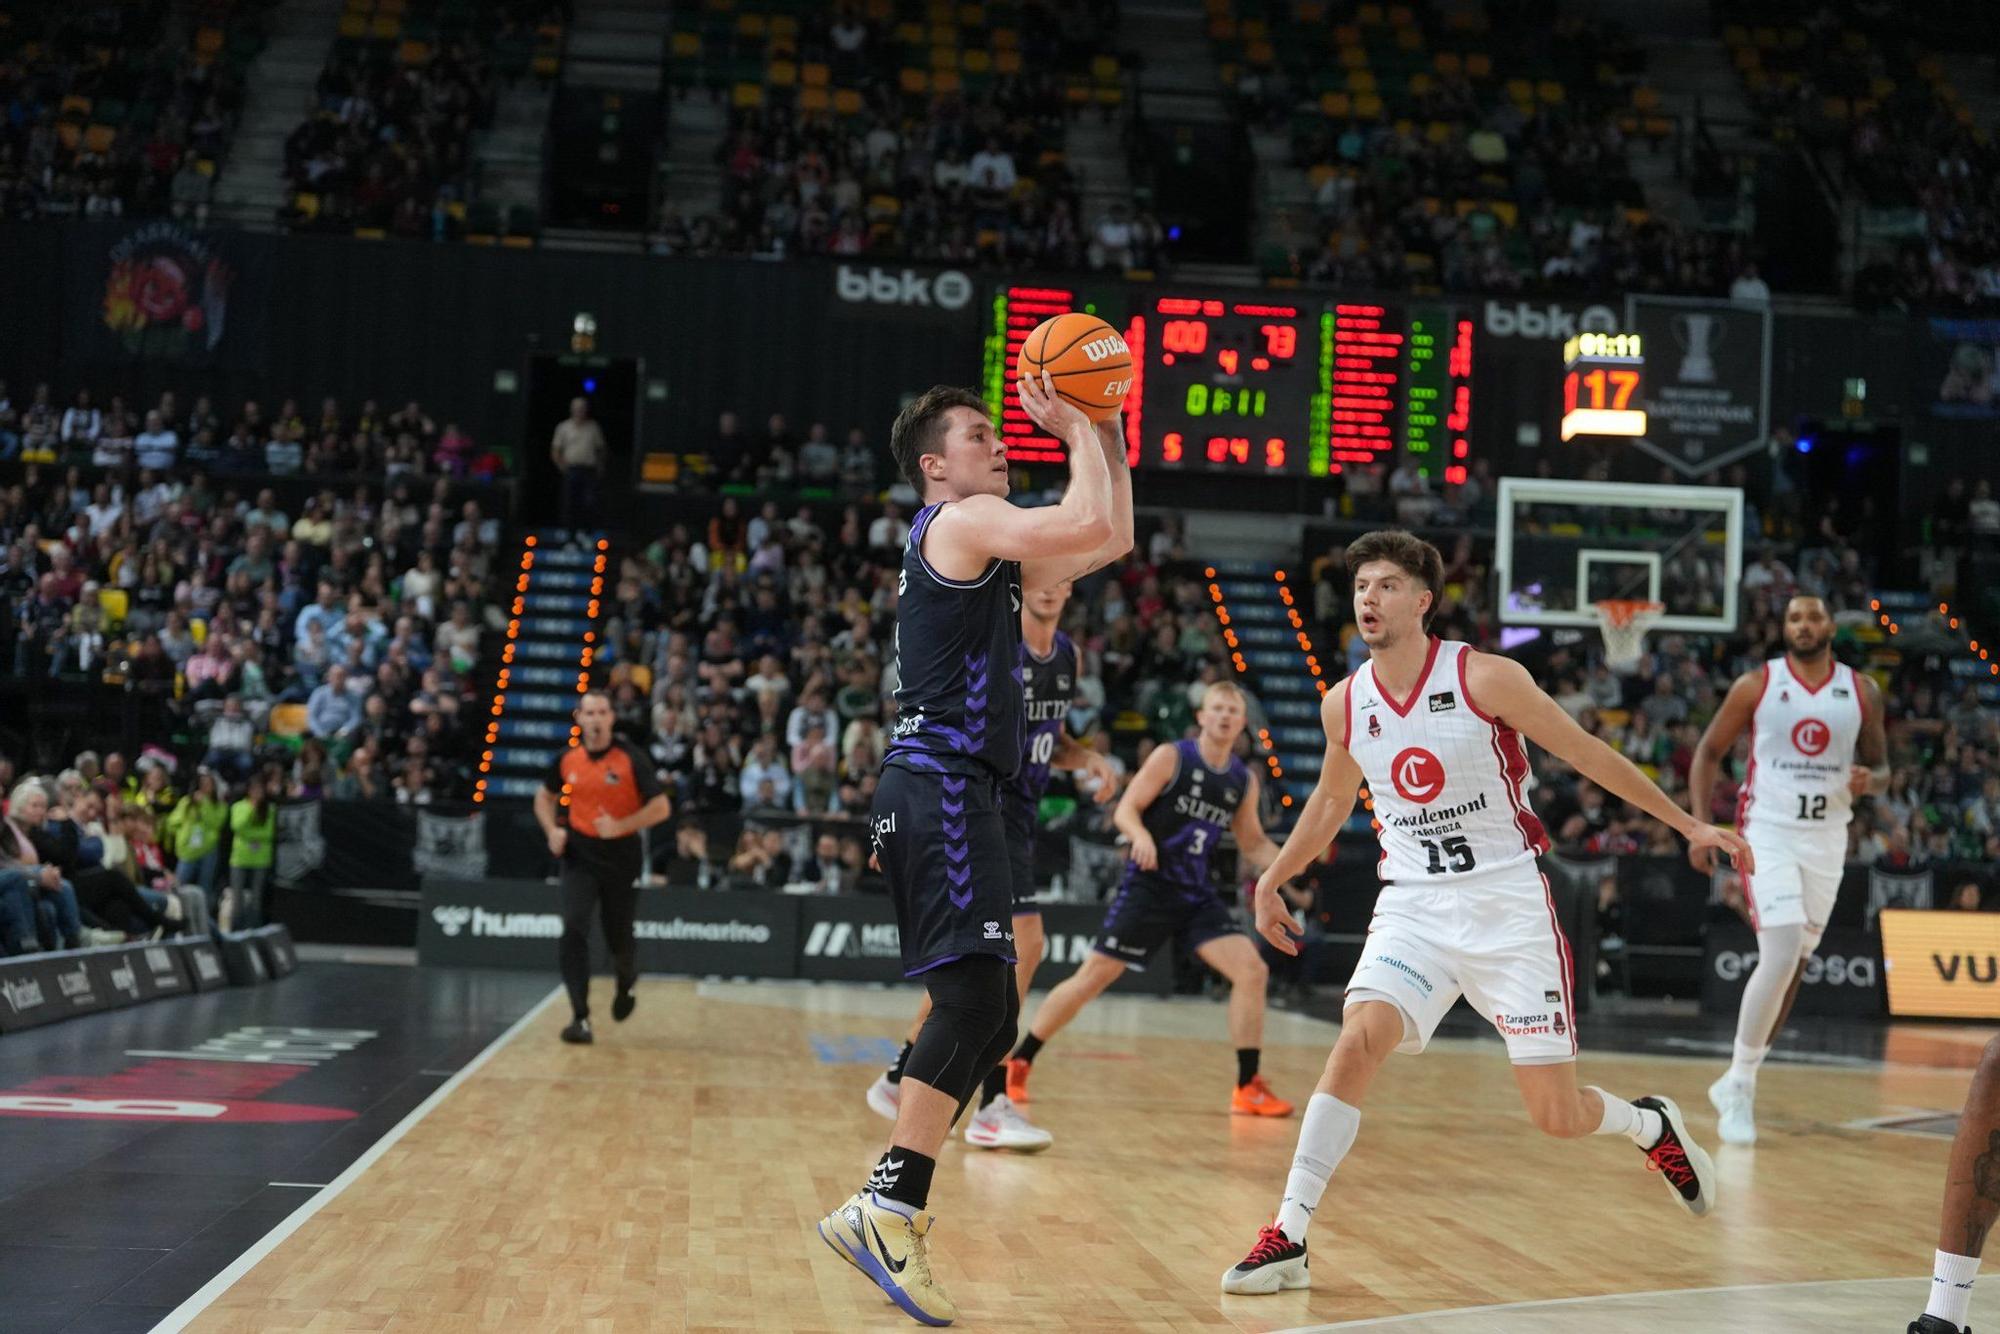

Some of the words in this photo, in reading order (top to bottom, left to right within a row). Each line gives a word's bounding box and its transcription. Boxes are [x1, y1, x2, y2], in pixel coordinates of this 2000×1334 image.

[837, 266, 930, 304] bbk
[1485, 302, 1575, 339] bbk
[1584, 368, 1640, 410] 17
[1030, 732, 1054, 764] 10
[1385, 792, 1488, 827] asademont
[1796, 794, 1827, 820] 12
[1188, 828, 1208, 855] 3
[1420, 835, 1476, 875] 15
[1375, 955, 1433, 992] azulmarino
[1505, 1014, 1548, 1026] Zaragoza
